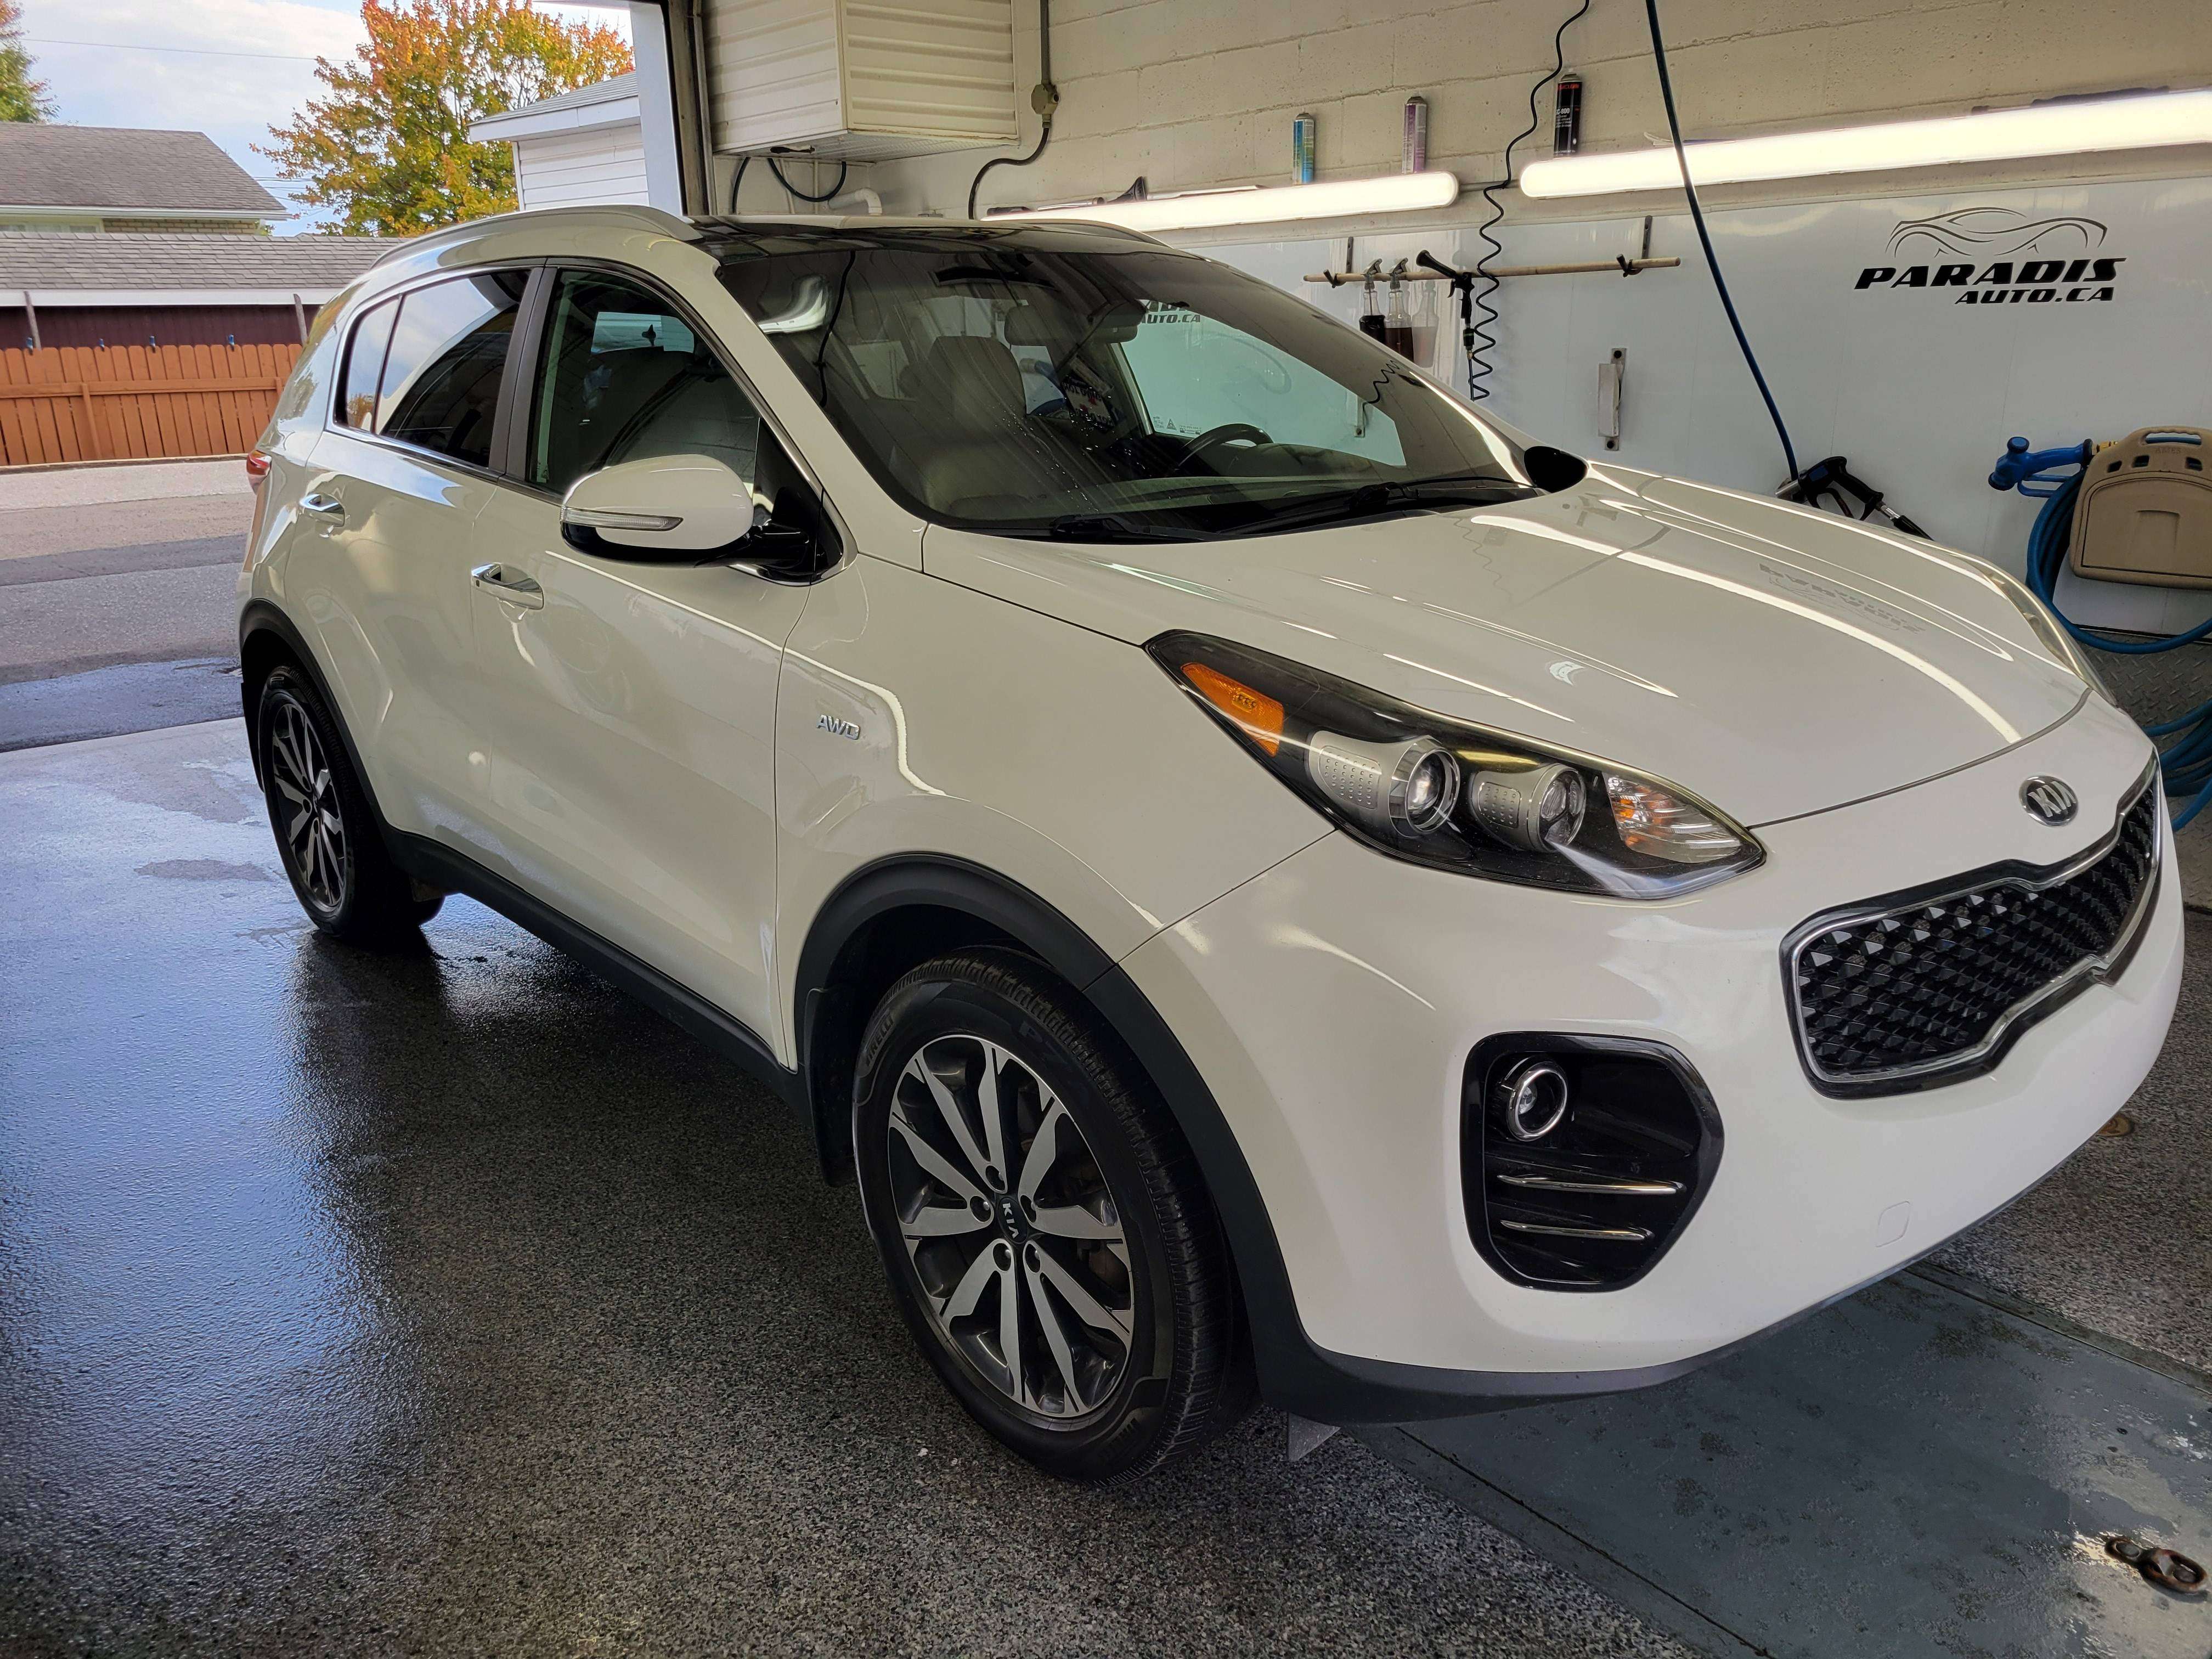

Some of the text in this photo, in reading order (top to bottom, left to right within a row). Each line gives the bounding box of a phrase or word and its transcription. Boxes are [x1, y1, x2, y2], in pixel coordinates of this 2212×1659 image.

[1854, 257, 2127, 290] PARADIS
[1954, 287, 2115, 304] AUTO.CA
[816, 714, 861, 741] AWD
[2027, 781, 2077, 817] KIA
[1002, 1202, 1019, 1239] KIA
